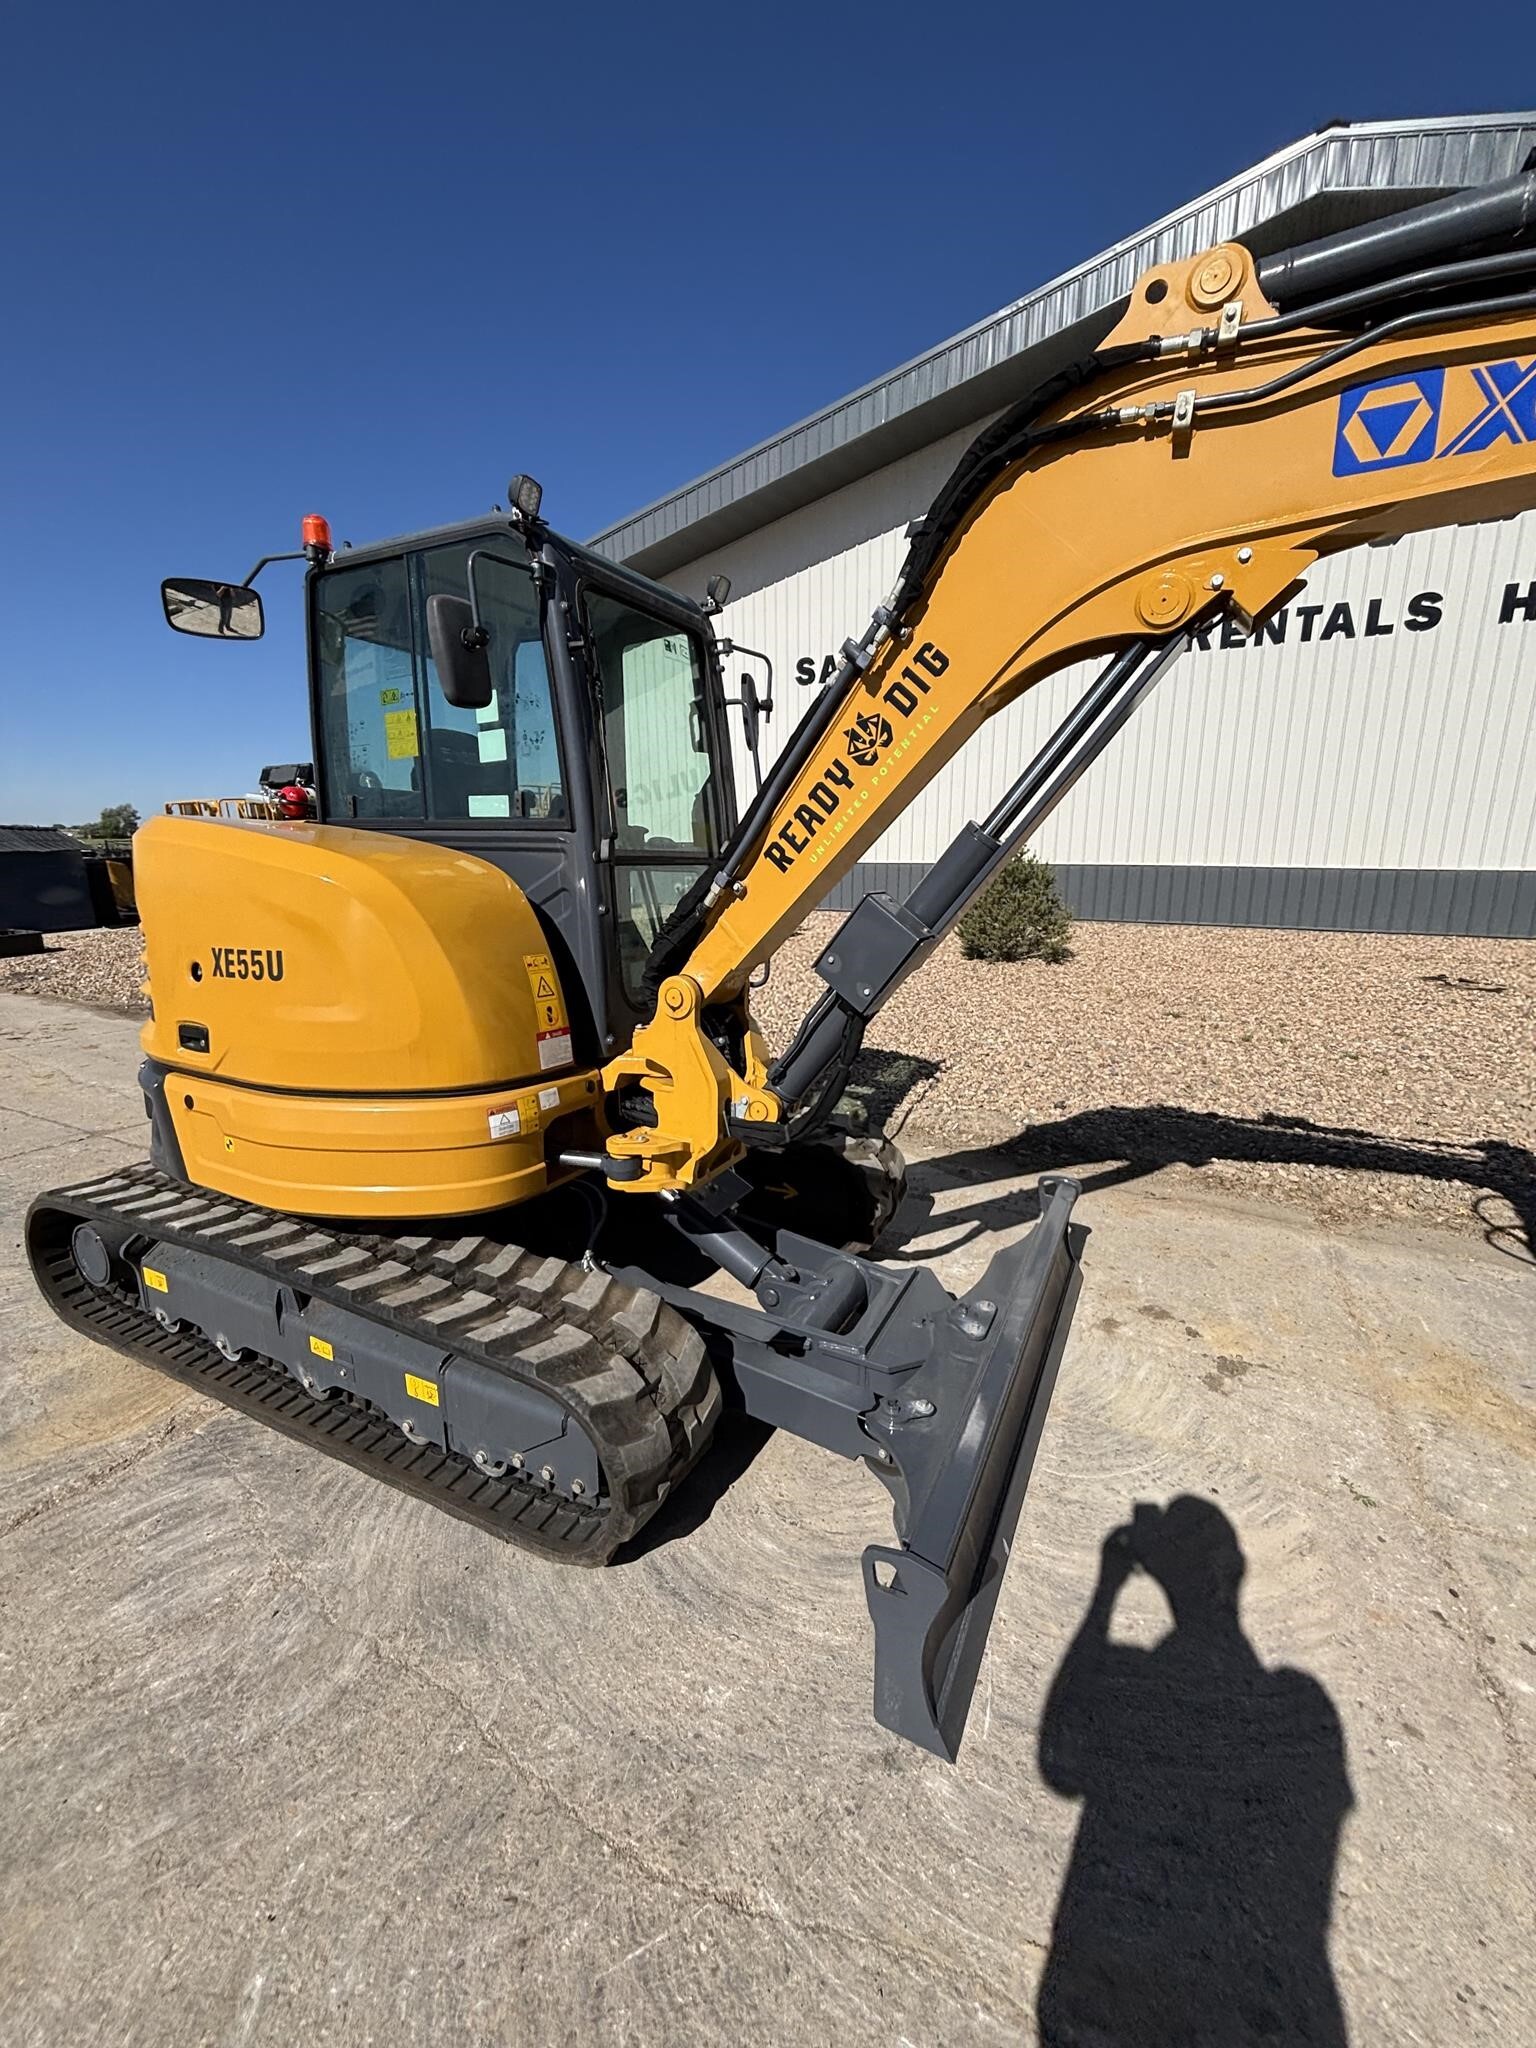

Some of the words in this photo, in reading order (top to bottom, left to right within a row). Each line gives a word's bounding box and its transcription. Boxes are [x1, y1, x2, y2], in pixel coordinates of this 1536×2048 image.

[763, 758, 854, 874] READY
[882, 641, 949, 718] DIG
[809, 790, 869, 864] UNLIMITED
[871, 705, 939, 785] POTENTIAL
[211, 947, 284, 982] XE55U
